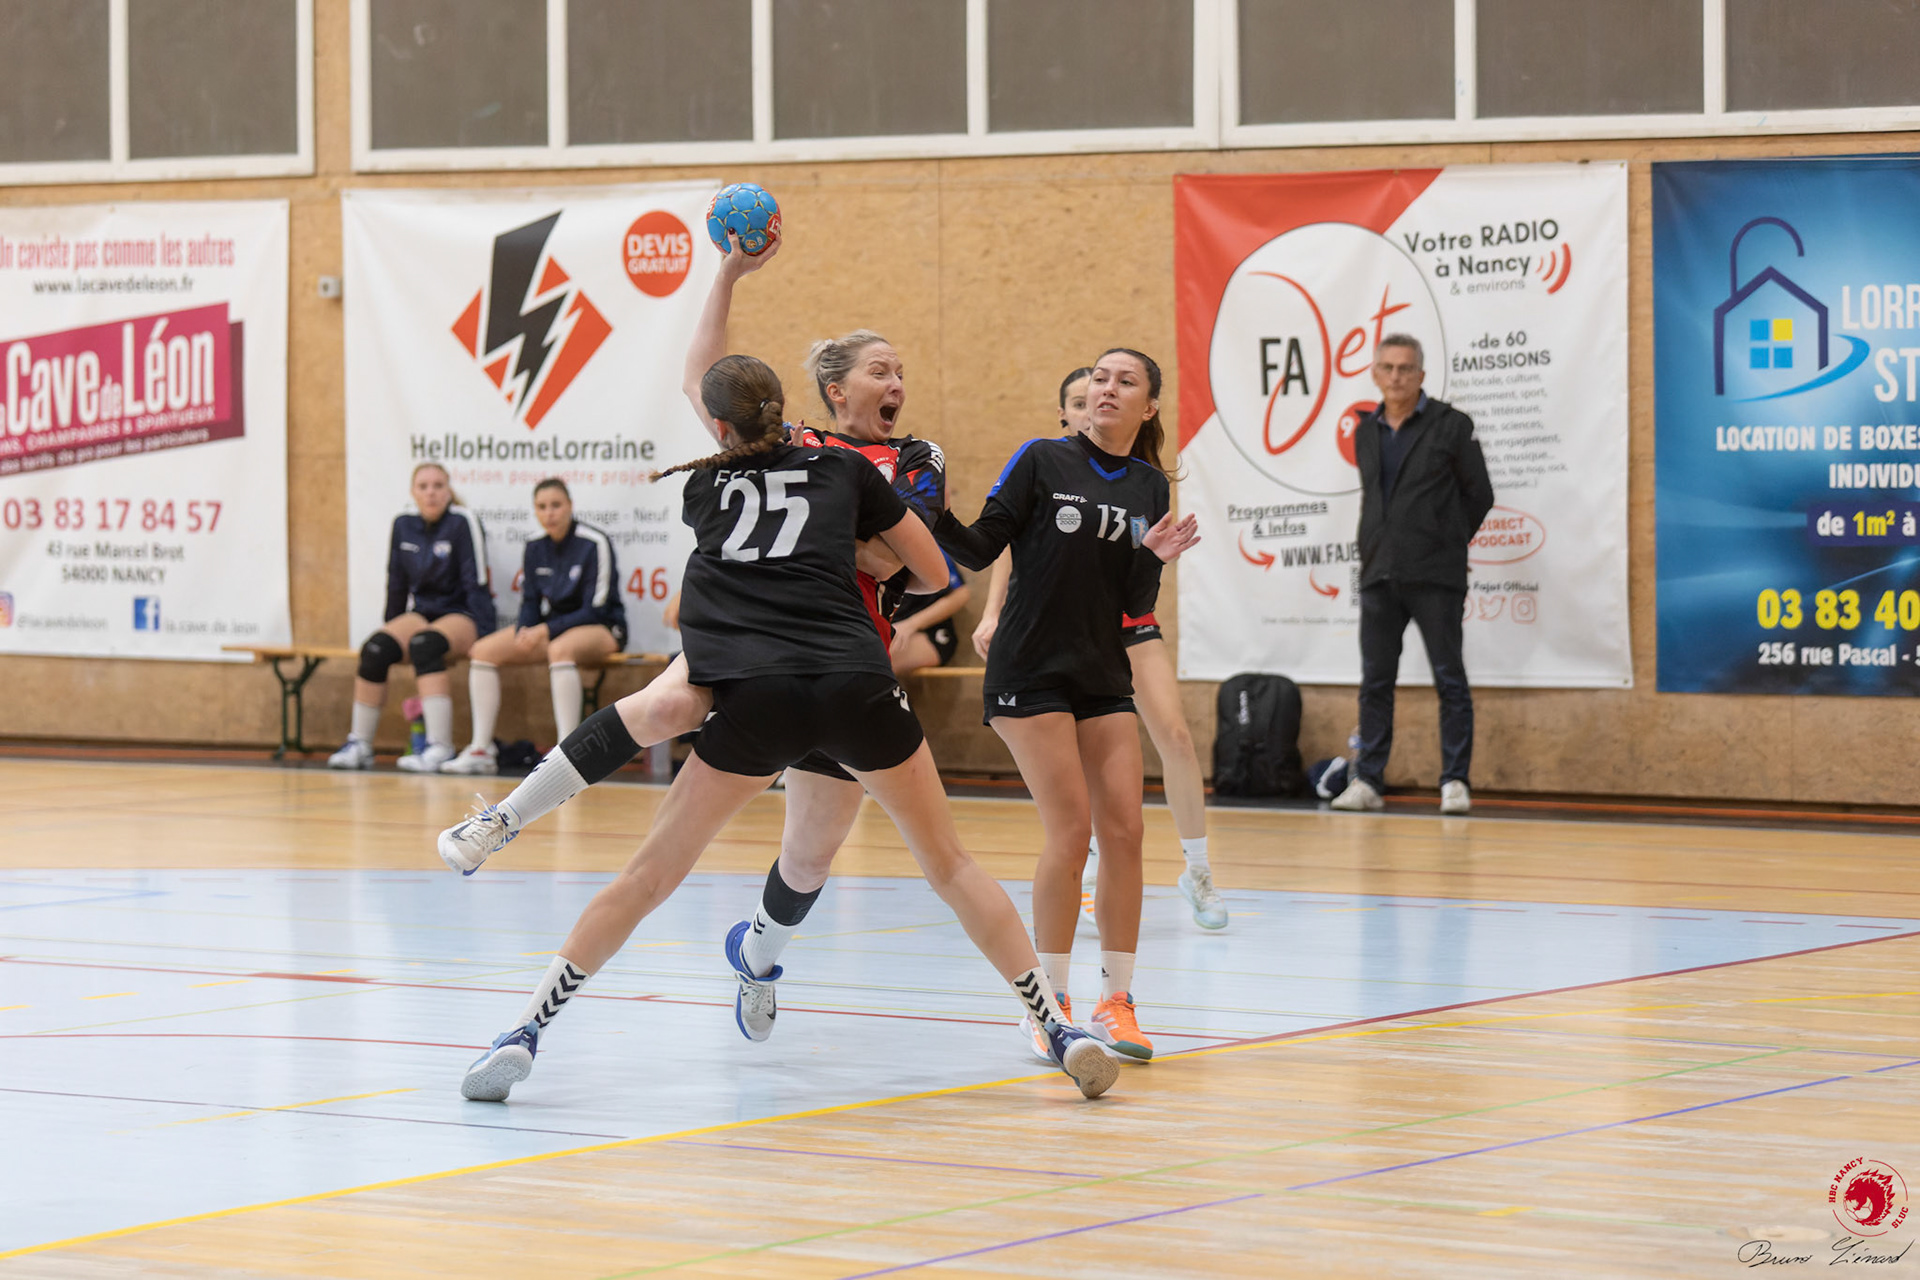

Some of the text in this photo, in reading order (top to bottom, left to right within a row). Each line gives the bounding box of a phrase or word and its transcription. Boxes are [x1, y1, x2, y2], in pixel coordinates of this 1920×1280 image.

[627, 233, 690, 258] DEVIS
[1404, 219, 1559, 253] Votre RADIO
[74, 239, 98, 273] pas
[102, 239, 157, 267] comme
[161, 232, 183, 266] les
[187, 233, 235, 266] autres
[628, 257, 689, 274] GRATUIT
[1435, 254, 1531, 277] à Nancy
[1467, 278, 1526, 294] environs
[1842, 283, 1920, 330] LORR
[1505, 331, 1527, 347] 60
[1452, 350, 1552, 373] ÉMISSIONS
[1874, 347, 1920, 402] ST
[6, 316, 215, 436] Cave de Léon
[410, 433, 656, 461] HelloHomeLorraine
[1716, 424, 1920, 451] LOCATION DE BOXE
[1052, 492, 1080, 503] CRAFT
[1227, 500, 1329, 519] Programmes
[4, 498, 223, 534] 03 83 17 84 57
[720, 470, 810, 562] 25
[1096, 503, 1127, 542] 13
[1268, 518, 1307, 534] Infos
[1816, 510, 1846, 536] de
[1902, 510, 1916, 537] à
[66, 543, 89, 558] rue
[95, 540, 148, 559] Marcel
[1281, 541, 1360, 567] WWW.FAJE
[112, 565, 166, 584] NANCY
[626, 568, 668, 600] 46
[1757, 588, 1920, 631] 03 83 40
[1758, 643, 1796, 665] 256
[1801, 646, 1833, 665] rue
[1839, 643, 1896, 667] Pascal
